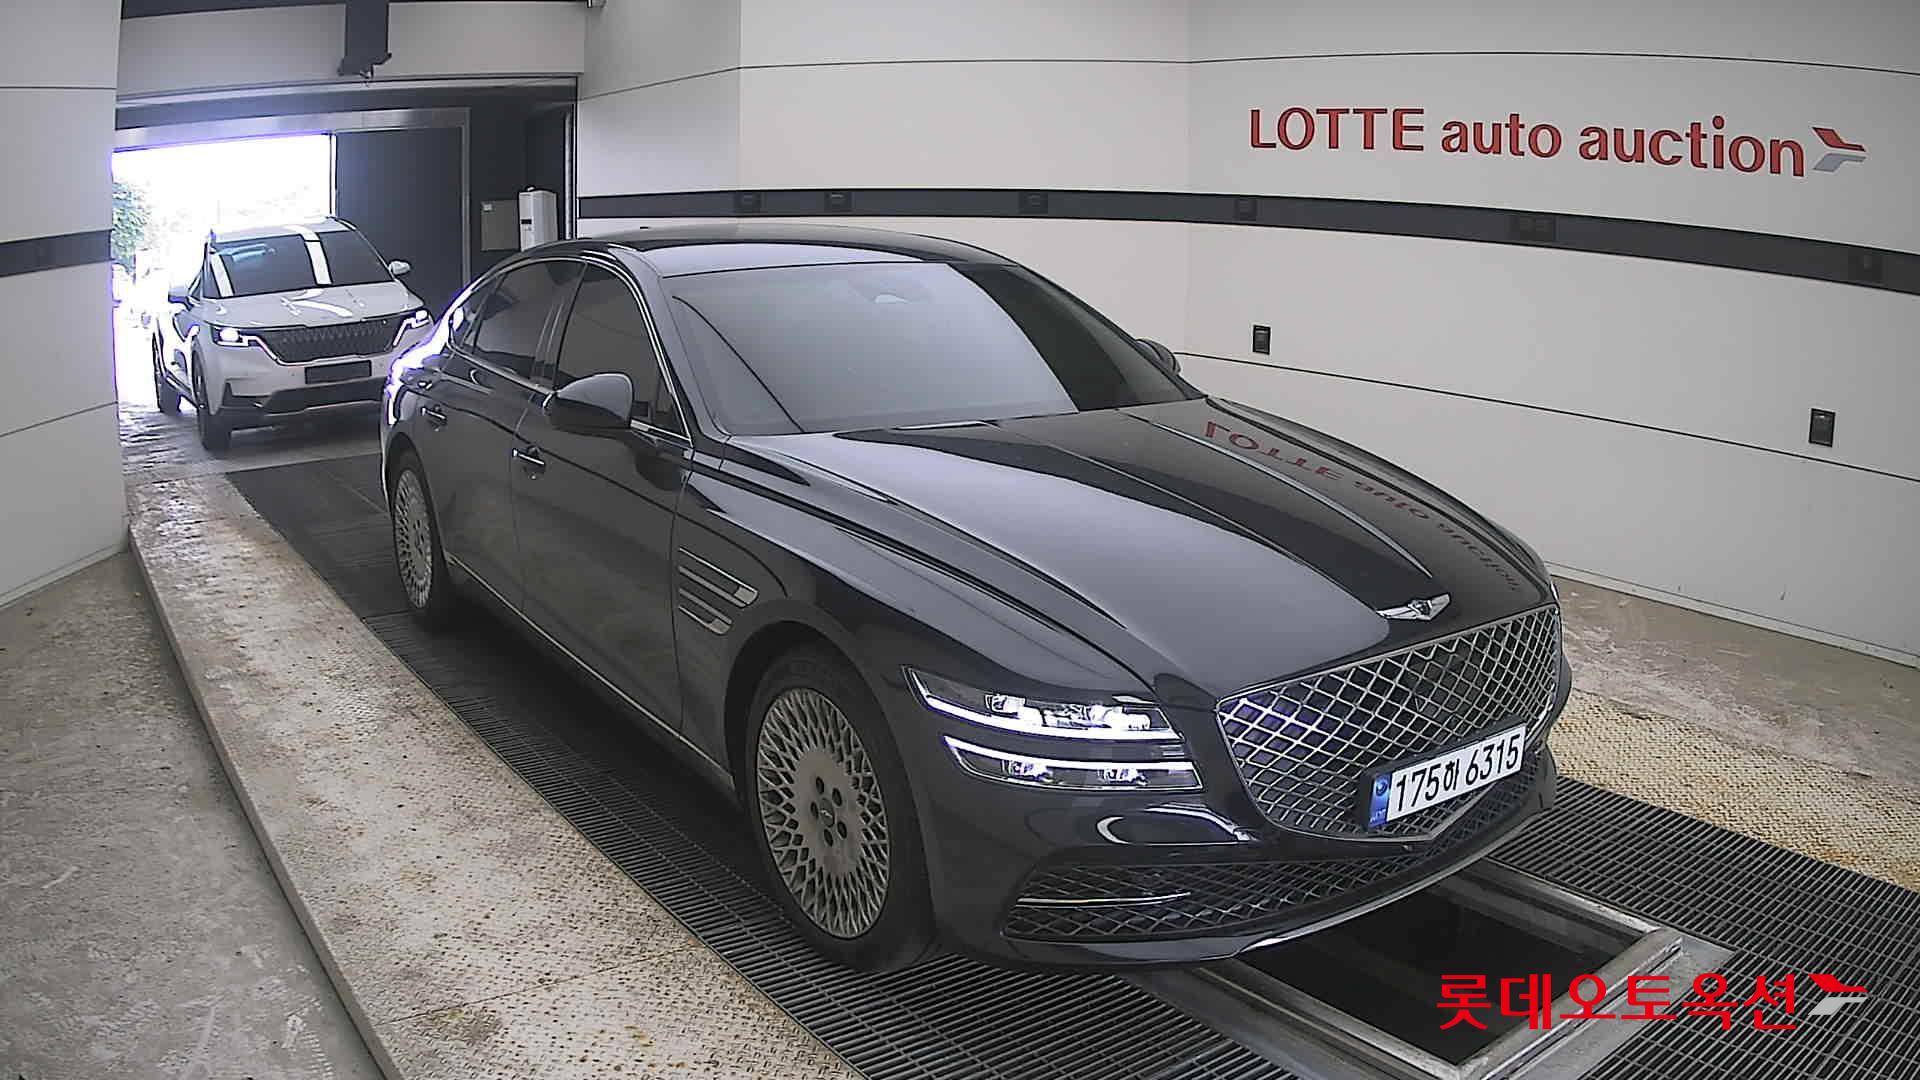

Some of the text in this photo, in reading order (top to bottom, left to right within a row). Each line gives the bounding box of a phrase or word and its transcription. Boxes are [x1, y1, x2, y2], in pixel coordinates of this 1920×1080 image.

[1250, 108, 1805, 178] LOTTE auto auction
[1396, 733, 1521, 812] 175하 6315
